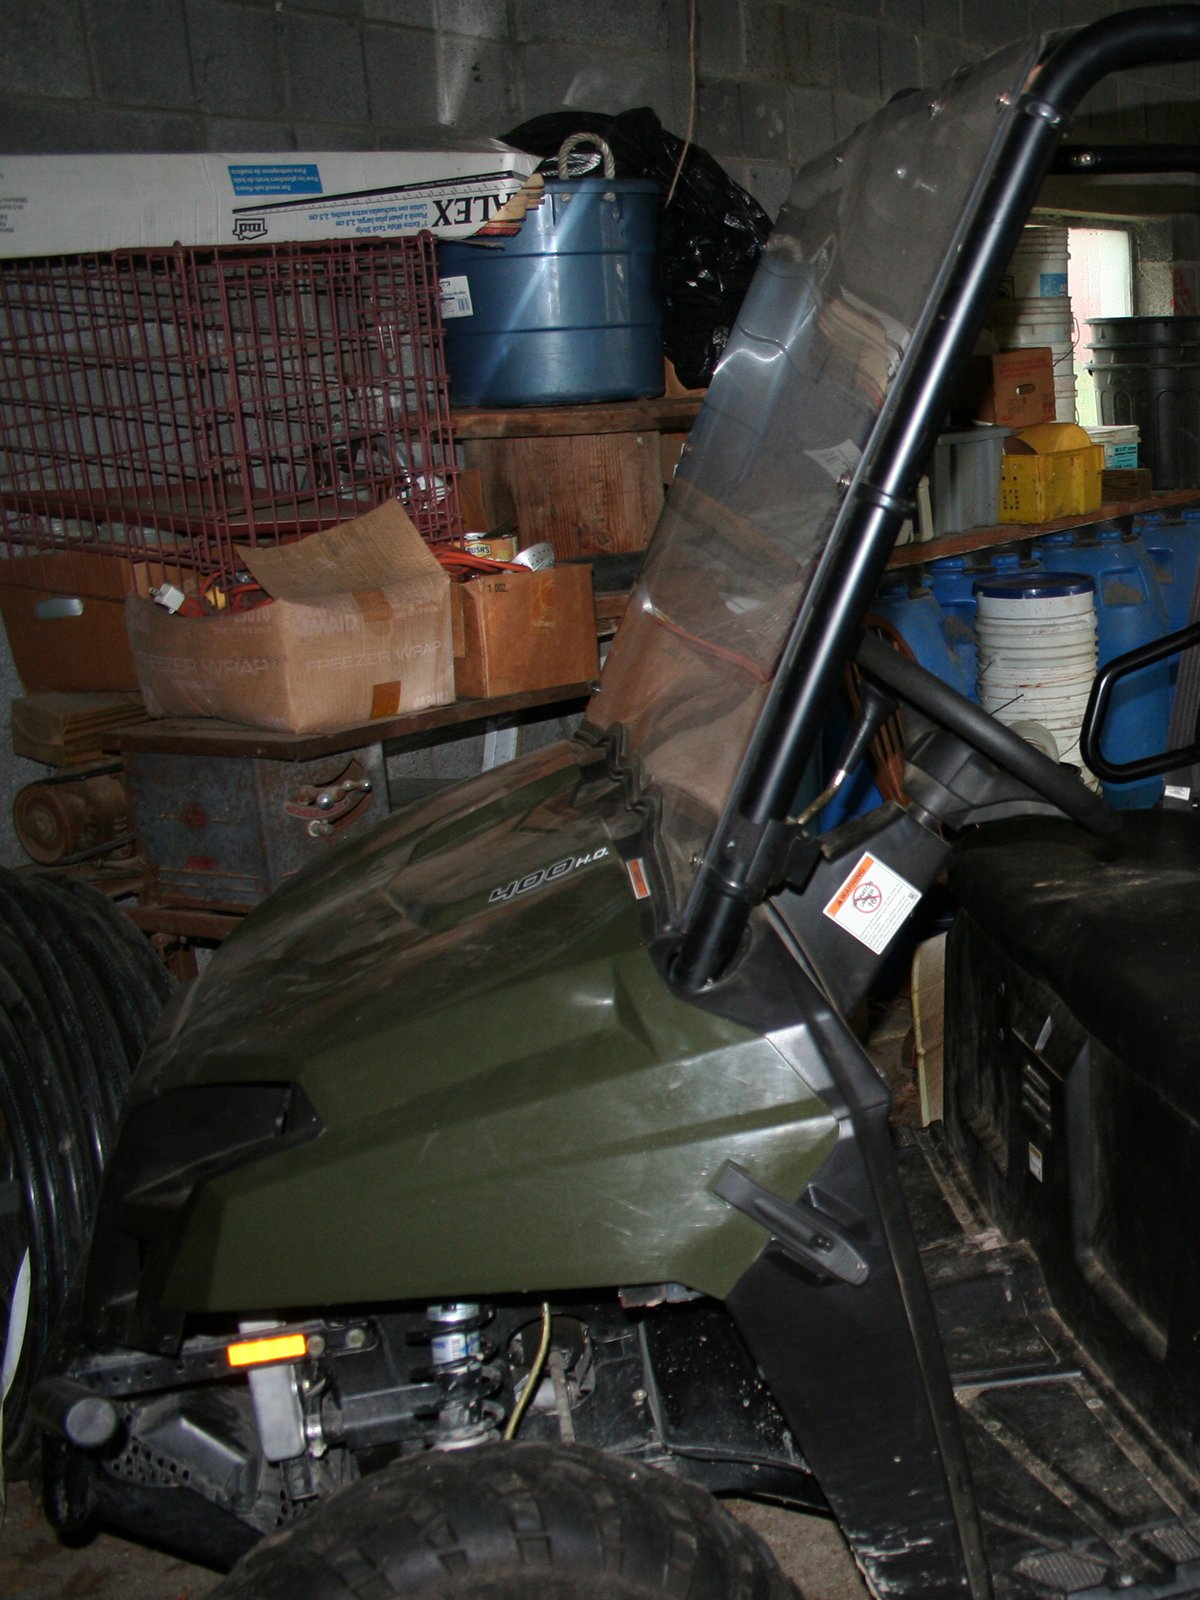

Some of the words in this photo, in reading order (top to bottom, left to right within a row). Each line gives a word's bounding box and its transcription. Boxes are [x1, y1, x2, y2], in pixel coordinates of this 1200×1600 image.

[466, 546, 491, 555] BUSH'S
[304, 652, 391, 673] FREEZER
[395, 640, 442, 663] WRAP
[488, 856, 578, 903] 400
[839, 867, 866, 900] WARNING
